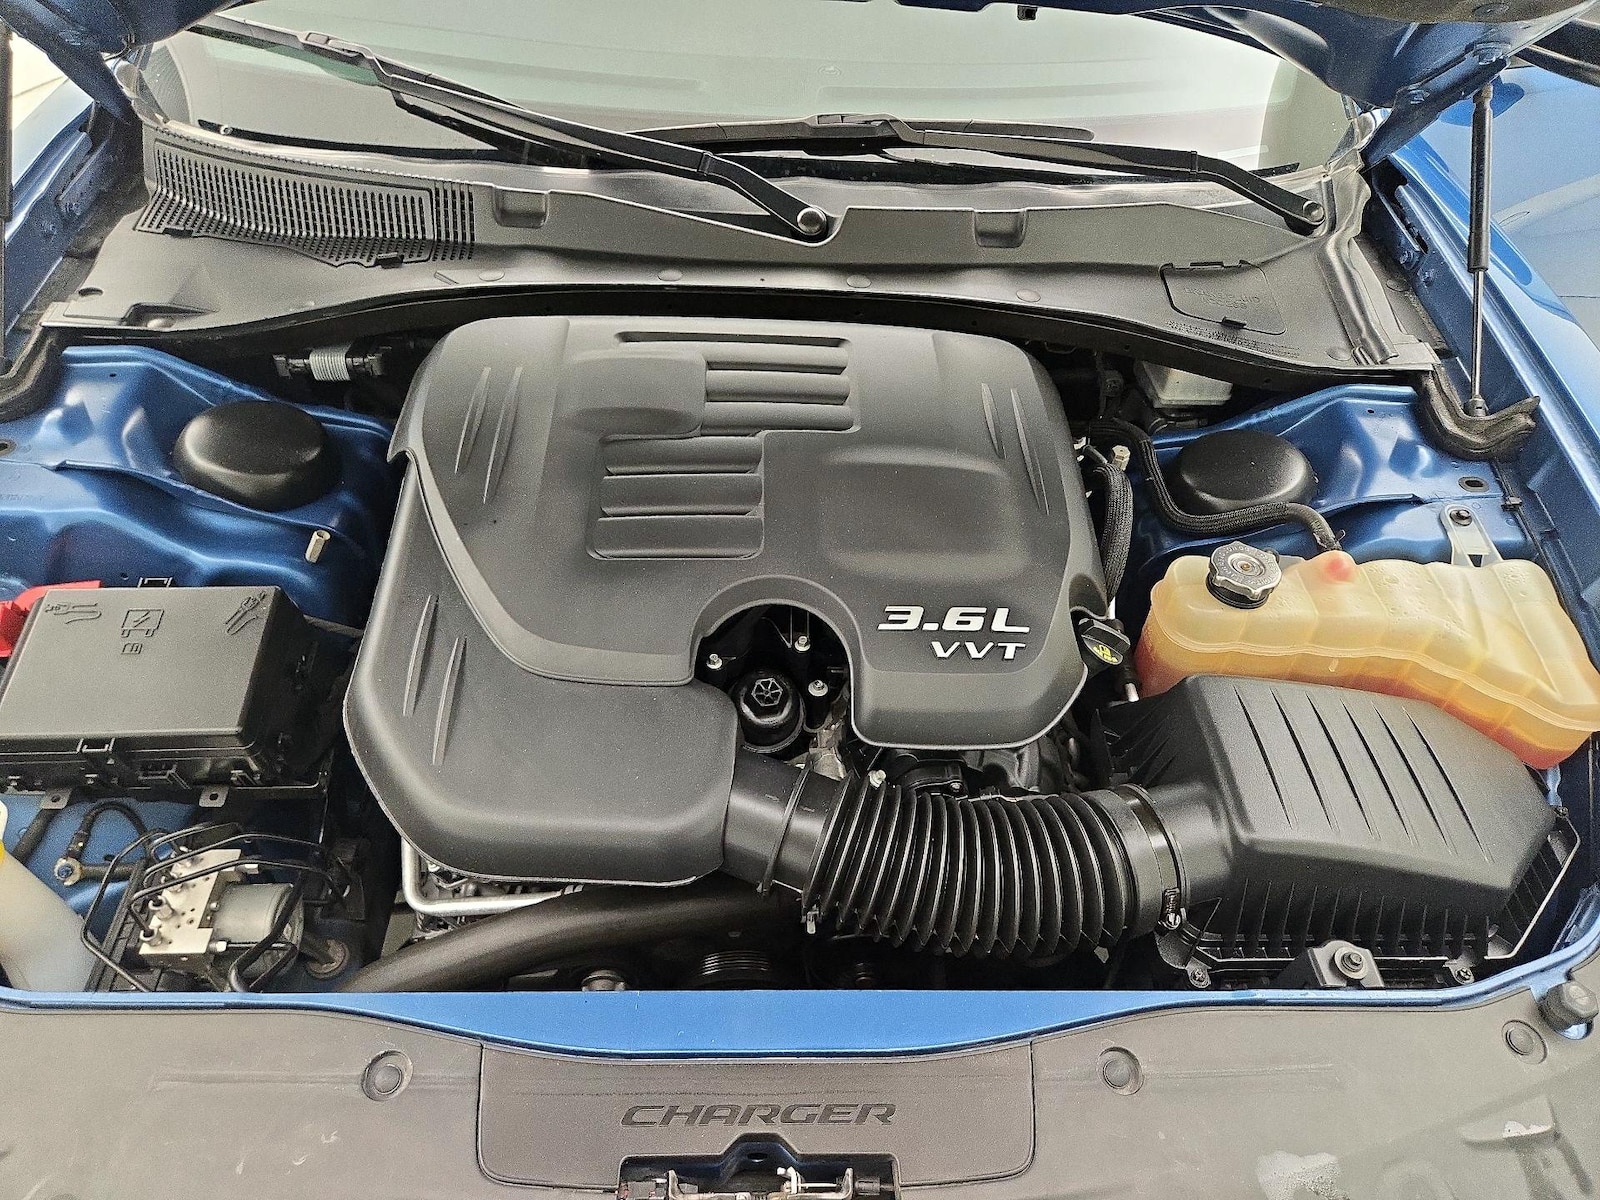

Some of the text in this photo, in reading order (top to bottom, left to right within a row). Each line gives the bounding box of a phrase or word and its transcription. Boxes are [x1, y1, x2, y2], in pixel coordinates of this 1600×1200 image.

[877, 605, 1030, 633] 3.6L
[931, 641, 1026, 660] VVT
[621, 1103, 896, 1126] CHARGER
